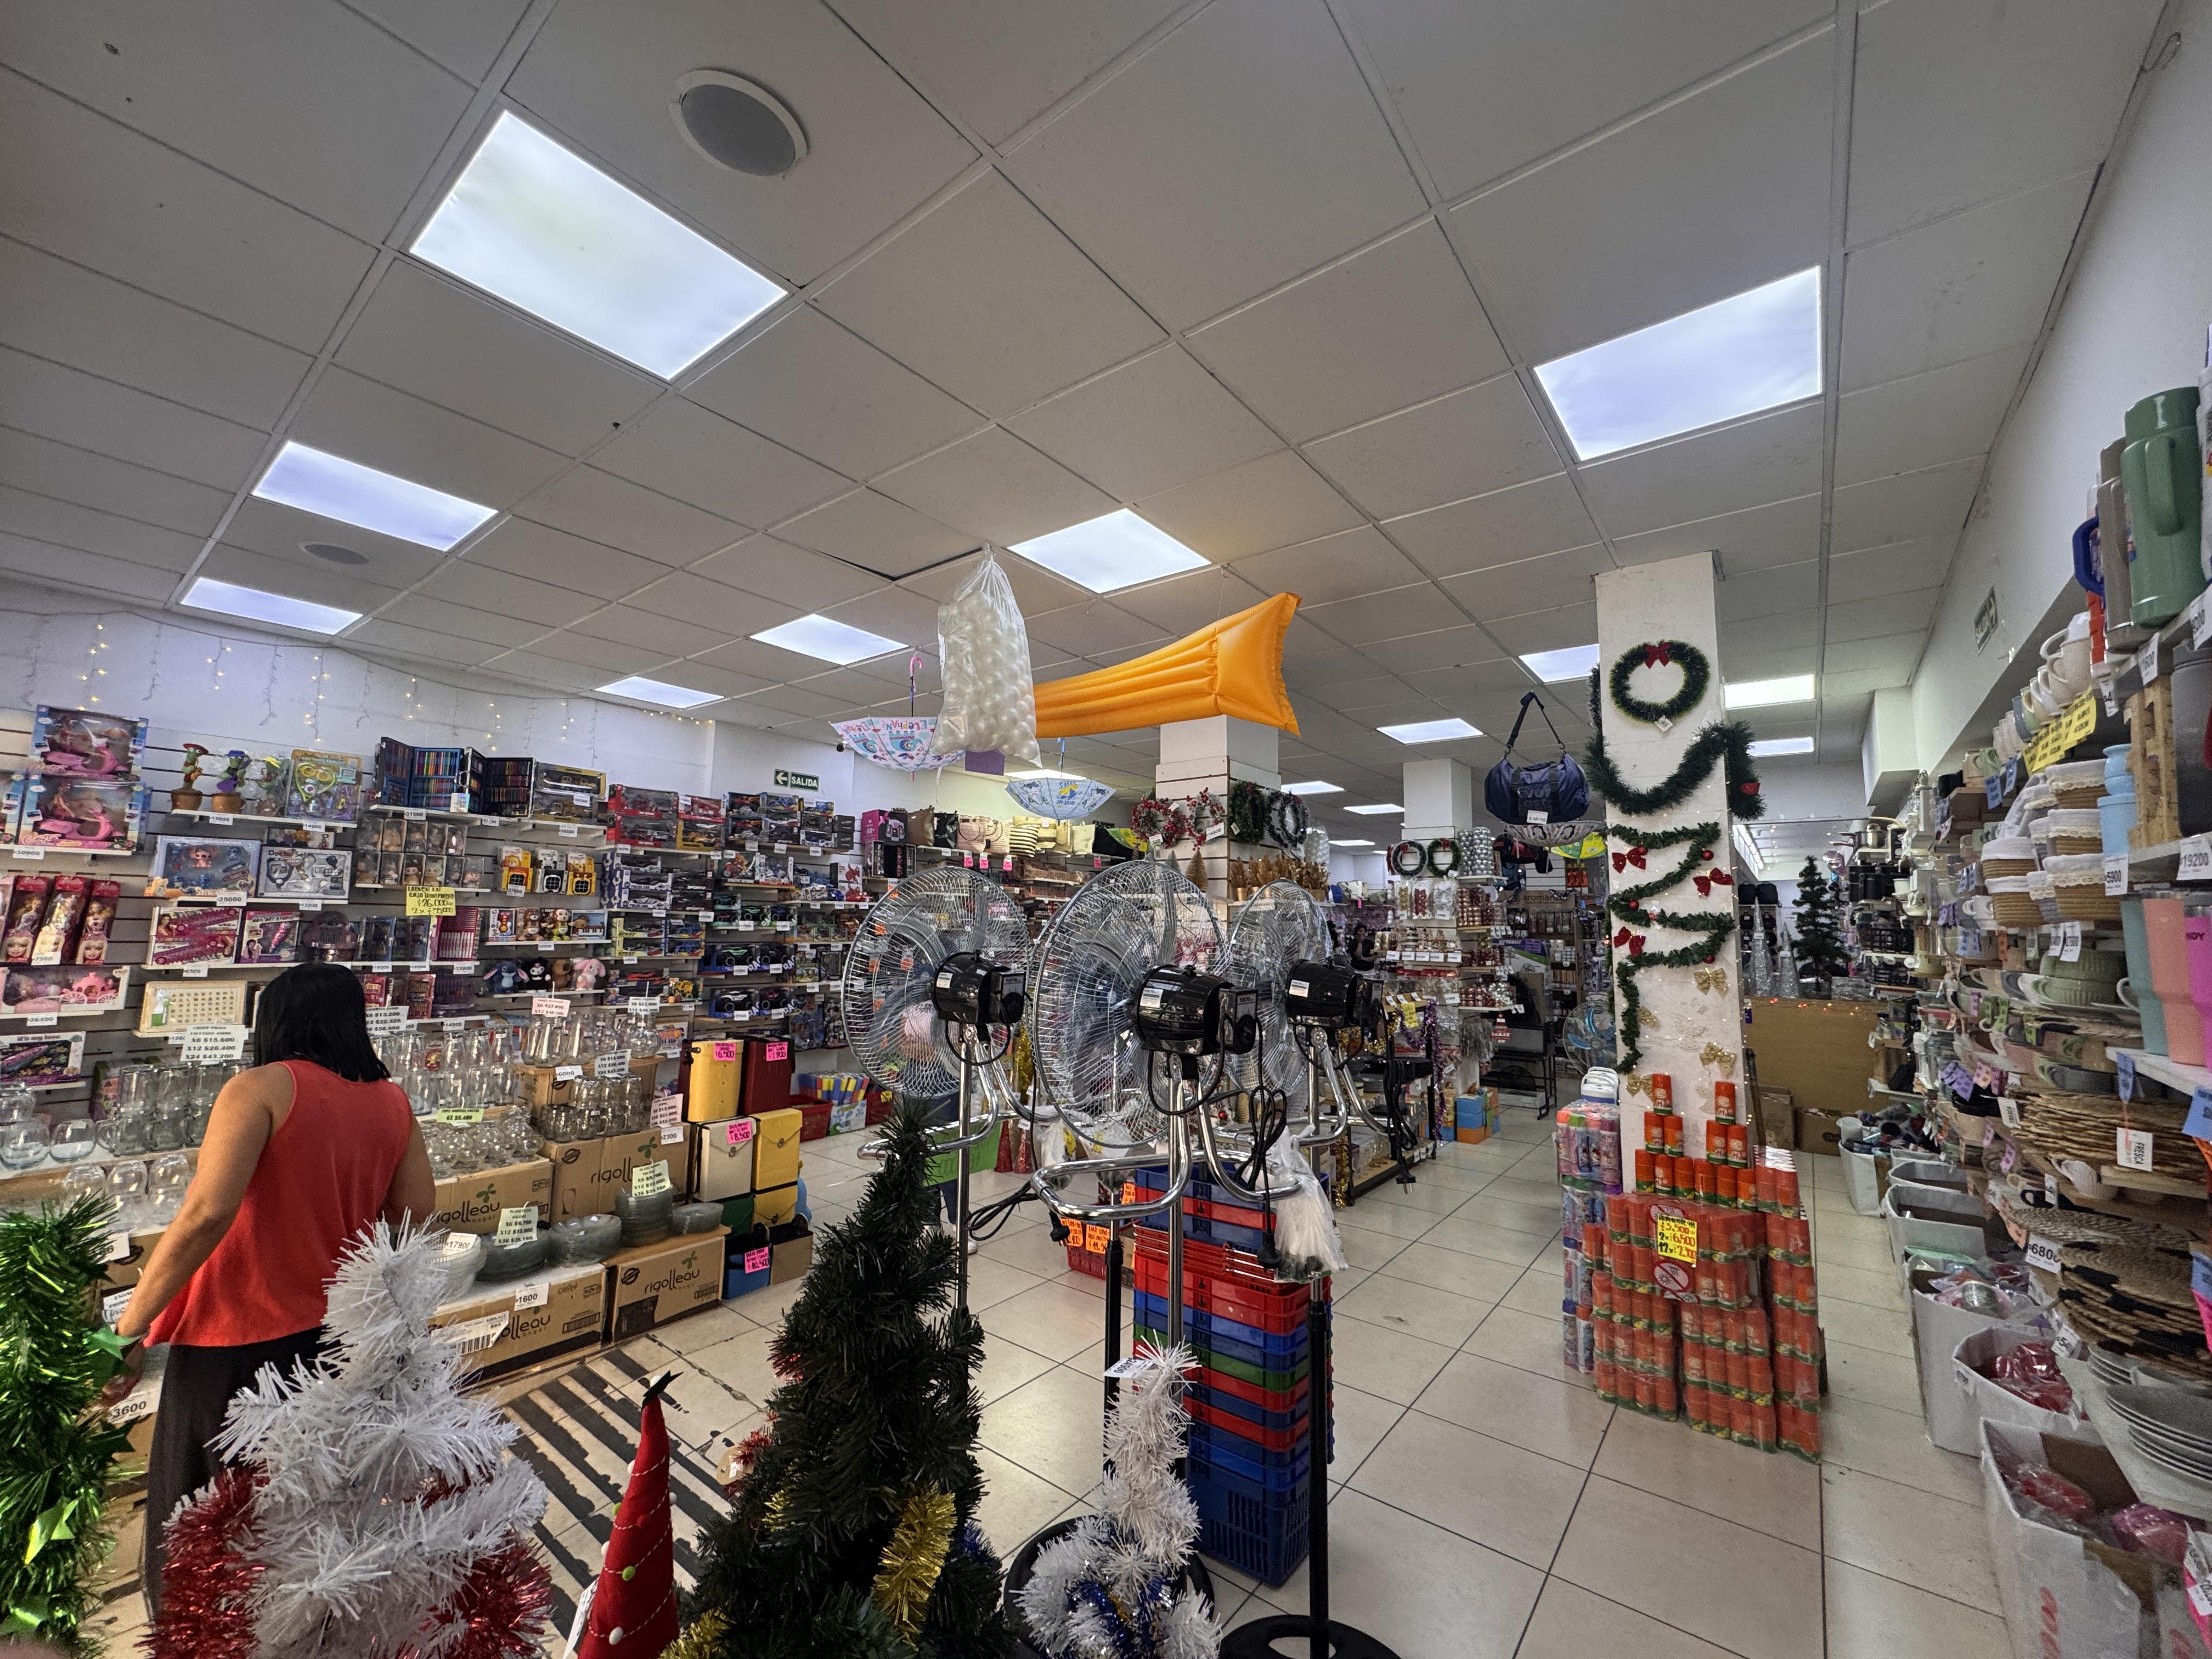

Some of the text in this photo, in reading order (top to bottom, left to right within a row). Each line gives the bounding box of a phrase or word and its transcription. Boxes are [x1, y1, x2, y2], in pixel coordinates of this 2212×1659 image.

[791, 776, 817, 787] SALIDA
[437, 1200, 500, 1224] igolleau
[645, 1268, 699, 1294] rigolleau
[501, 1314, 551, 1340] olleau
